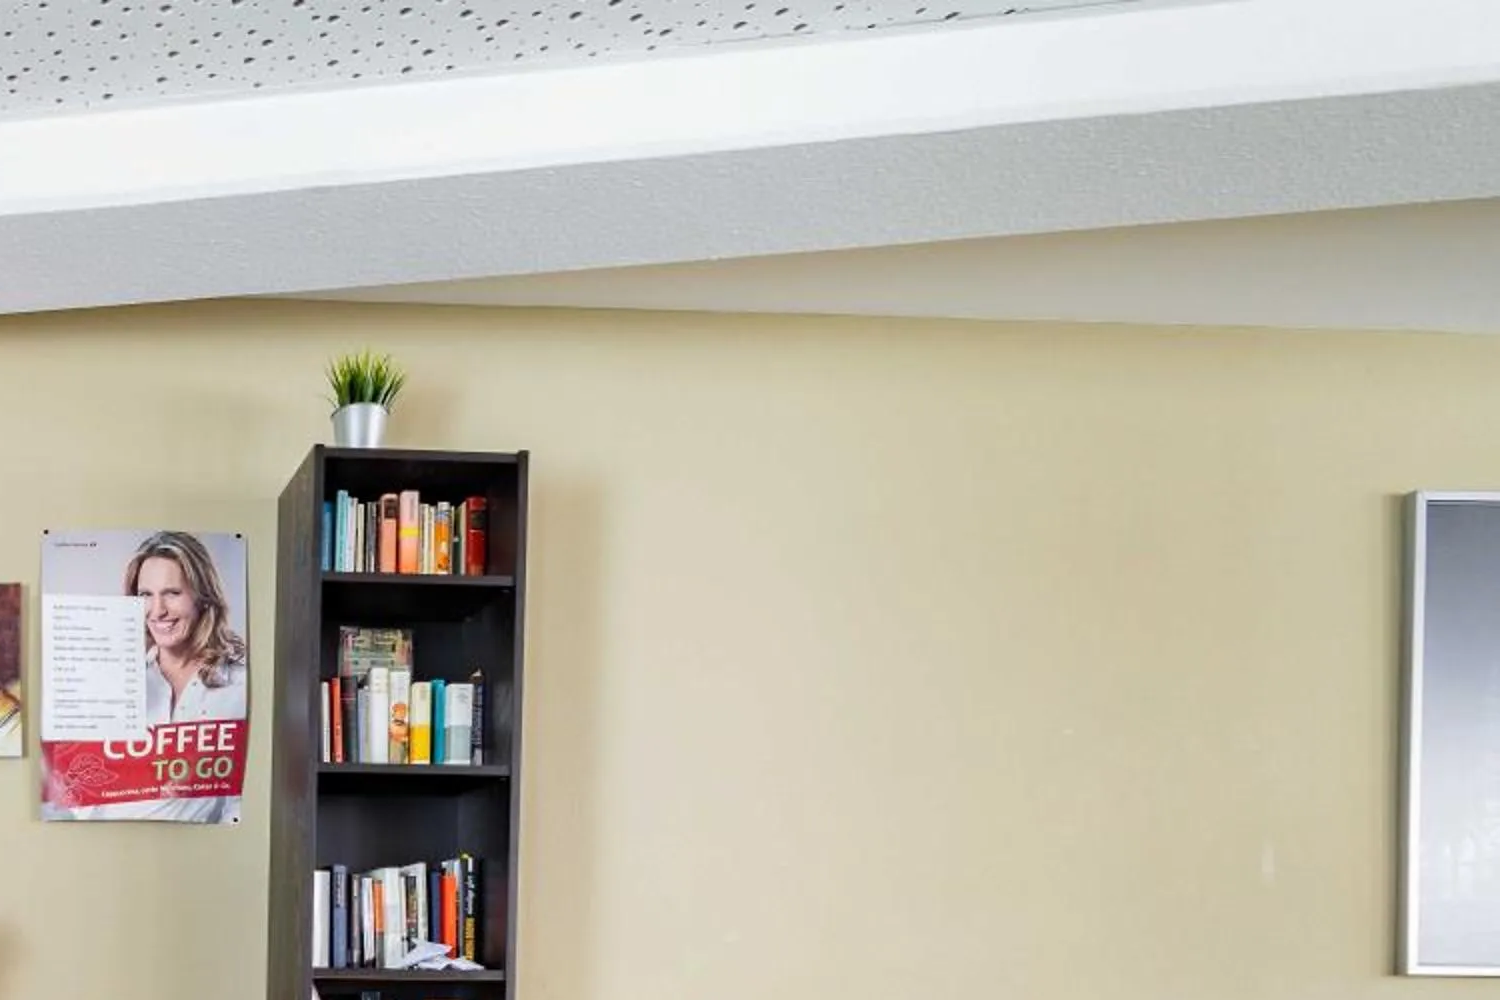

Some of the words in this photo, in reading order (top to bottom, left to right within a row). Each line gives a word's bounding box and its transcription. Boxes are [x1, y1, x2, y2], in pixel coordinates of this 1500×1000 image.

[103, 722, 237, 760] COFFEE
[152, 758, 190, 782] TO
[195, 755, 234, 779] GO
